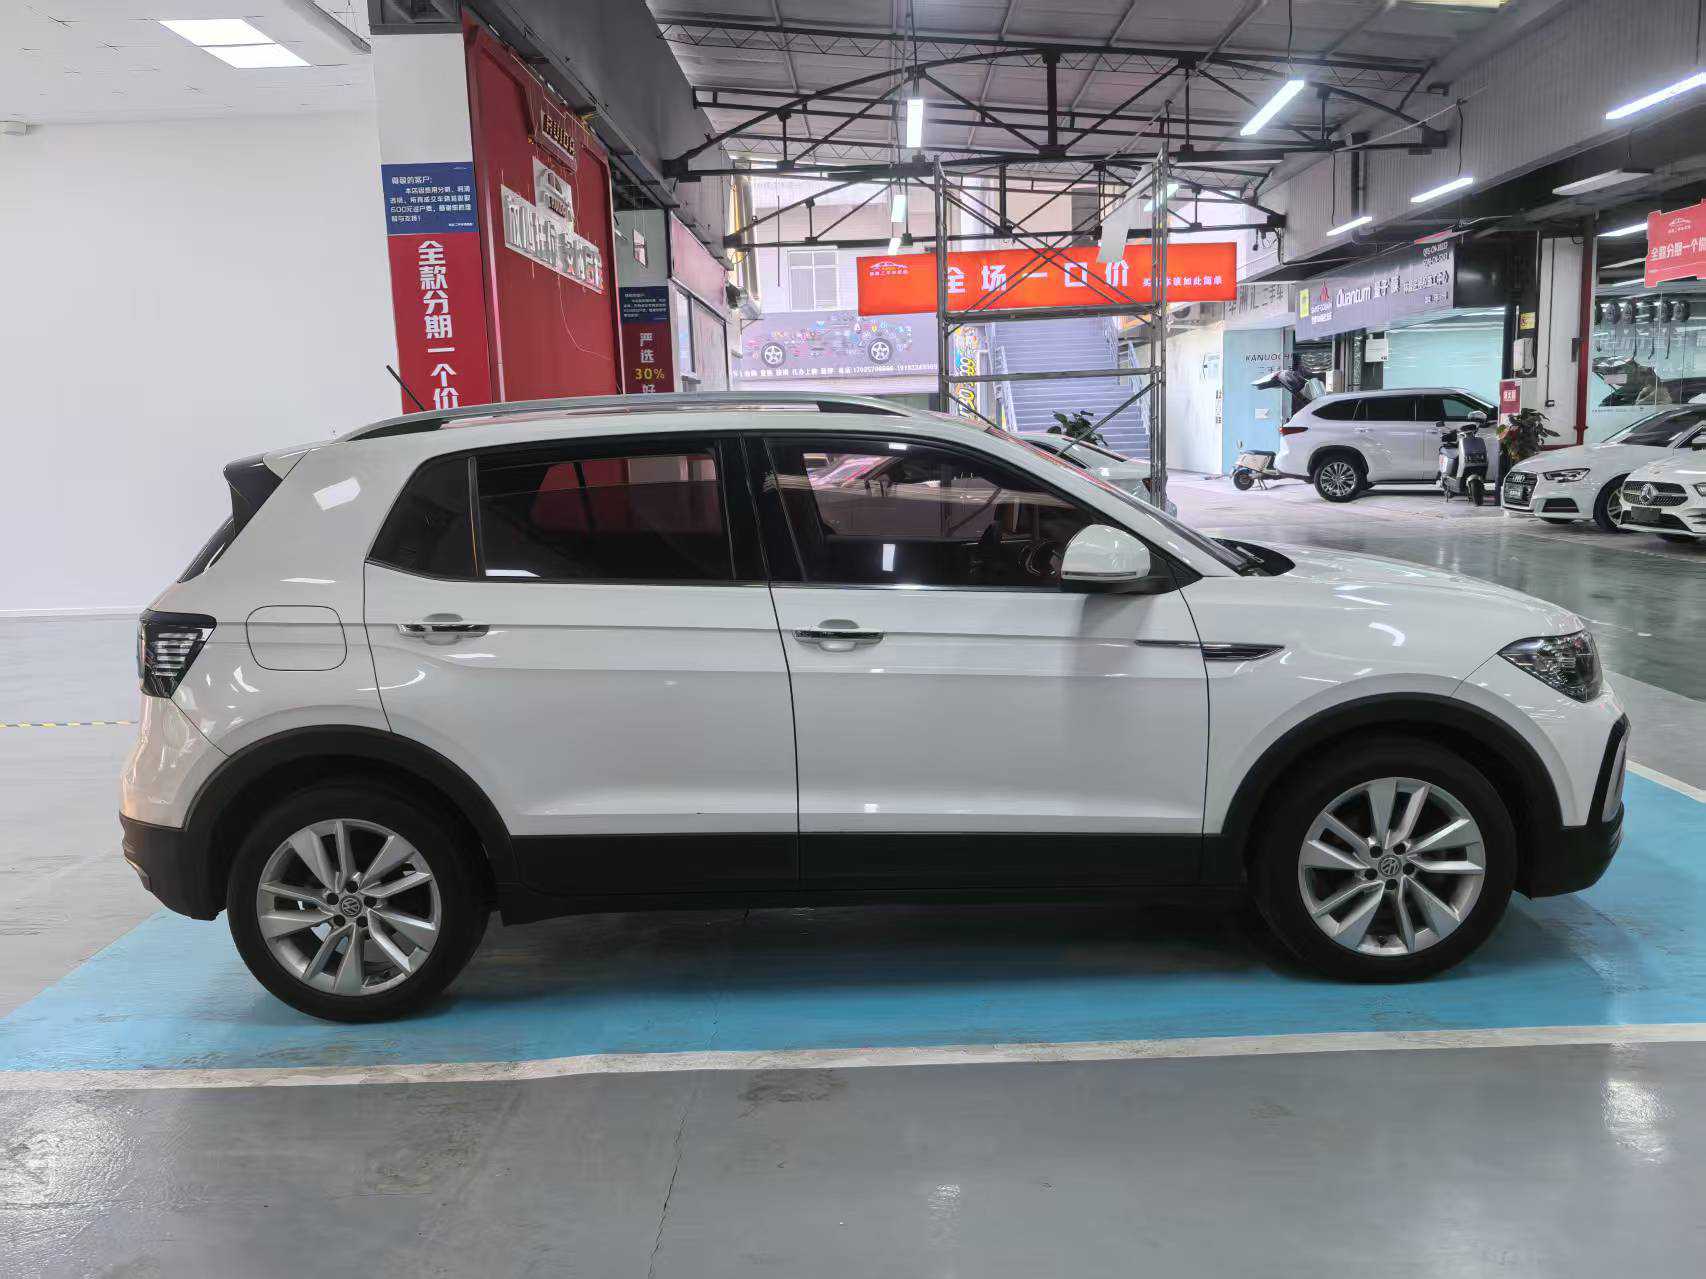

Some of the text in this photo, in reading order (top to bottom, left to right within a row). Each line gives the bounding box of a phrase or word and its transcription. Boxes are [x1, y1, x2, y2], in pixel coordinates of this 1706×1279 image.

[418, 240, 460, 410] 全款分期一个价
